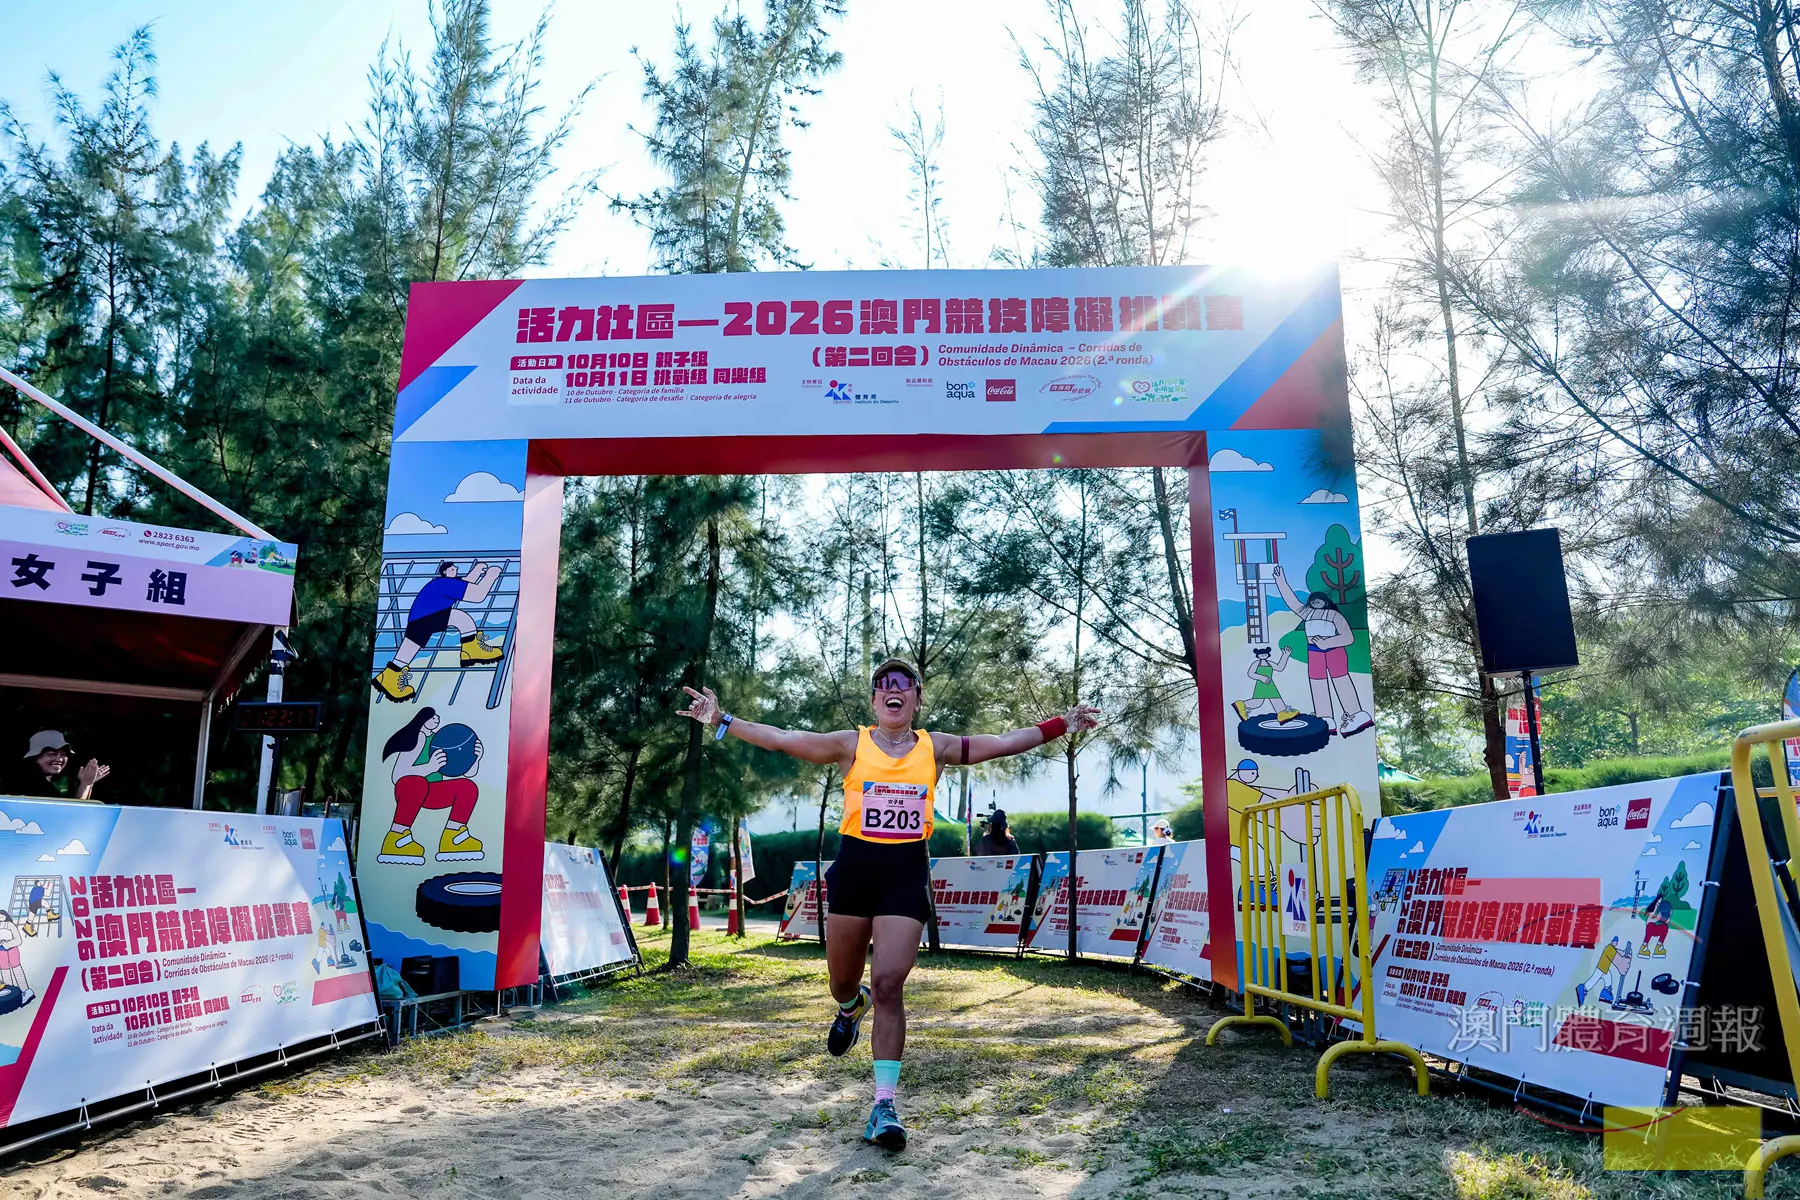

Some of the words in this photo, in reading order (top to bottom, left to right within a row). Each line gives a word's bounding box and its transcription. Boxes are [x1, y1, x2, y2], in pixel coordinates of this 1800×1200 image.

[938, 344, 1009, 354] Comunidade
[1010, 342, 1063, 353] Dinâmica
[1078, 342, 1127, 353] Corridas
[1128, 342, 1143, 352] de
[517, 357, 558, 368] 活動日期
[567, 352, 649, 370] 10月10日
[655, 350, 708, 368] 親子組
[938, 356, 1001, 367] Obstáculos
[1003, 355, 1018, 366] de
[1019, 355, 1058, 366] Macau
[1059, 355, 1092, 366] 2026
[1115, 353, 1154, 366] ronda)
[512, 377, 533, 385] Data
[535, 375, 546, 384] da
[565, 369, 648, 388] 10月11日
[653, 368, 707, 386] 挑戰組
[713, 366, 767, 385] 同樂組
[511, 386, 559, 395] actividade
[575, 388, 585, 396] de
[586, 388, 613, 396] Outubro
[618, 387, 650, 397] Categoria
[660, 386, 684, 394] família
[946, 381, 969, 391] bon
[583, 395, 612, 403] Outubro
[616, 395, 648, 404] Categoria
[659, 394, 684, 402] desafio
[690, 393, 722, 402] Categoria
[733, 392, 757, 402] alegria
[946, 390, 975, 400] aqua
[153, 531, 173, 540] 2823
[174, 534, 195, 543] 6363
[138, 538, 200, 551] www.sport.gov.mo
[10, 553, 188, 606] 女子組
[1600, 806, 1615, 816] bon
[865, 808, 920, 830] B203
[1598, 816, 1618, 829] aqua
[282, 829, 294, 838] bon
[284, 838, 298, 848] aqua
[94, 901, 313, 959] 澳門競技障礙挑戰賽
[1406, 899, 1604, 949] 澳門競技障礙挑戰賽
[1436, 943, 1461, 953] Comunidade
[1461, 944, 1483, 954] Dinâmica
[162, 954, 200, 967] Comunidade
[200, 950, 226, 961] Dinâmica
[164, 966, 191, 979] Corridas
[191, 965, 199, 975] de
[199, 961, 230, 973] Obstáculos
[230, 960, 237, 968] de
[238, 957, 255, 967] Macau
[255, 955, 269, 964] 2026
[278, 951, 294, 961] ronda)
[1433, 953, 1451, 962] Corridas
[1450, 954, 1456, 962] de
[1456, 955, 1481, 966] Obstáculos
[1482, 957, 1489, 967] de
[1489, 959, 1507, 970] Macau
[1507, 962, 1523, 971] 2026
[1535, 965, 1555, 977] ronda)
[1403, 967, 1431, 985] 10月10日
[1400, 982, 1427, 999] 10月11日
[122, 991, 170, 1013] 10月10日
[124, 1007, 172, 1031] 10月11日
[91, 1024, 106, 1033] Data
[106, 1022, 114, 1031] da
[138, 1029, 155, 1038] Outubro
[157, 1025, 175, 1035] Categoria
[93, 1031, 124, 1045] actividade
[138, 1036, 155, 1045] Outubro
[157, 1032, 175, 1042] Categoria
[180, 1029, 193, 1037] desafio
